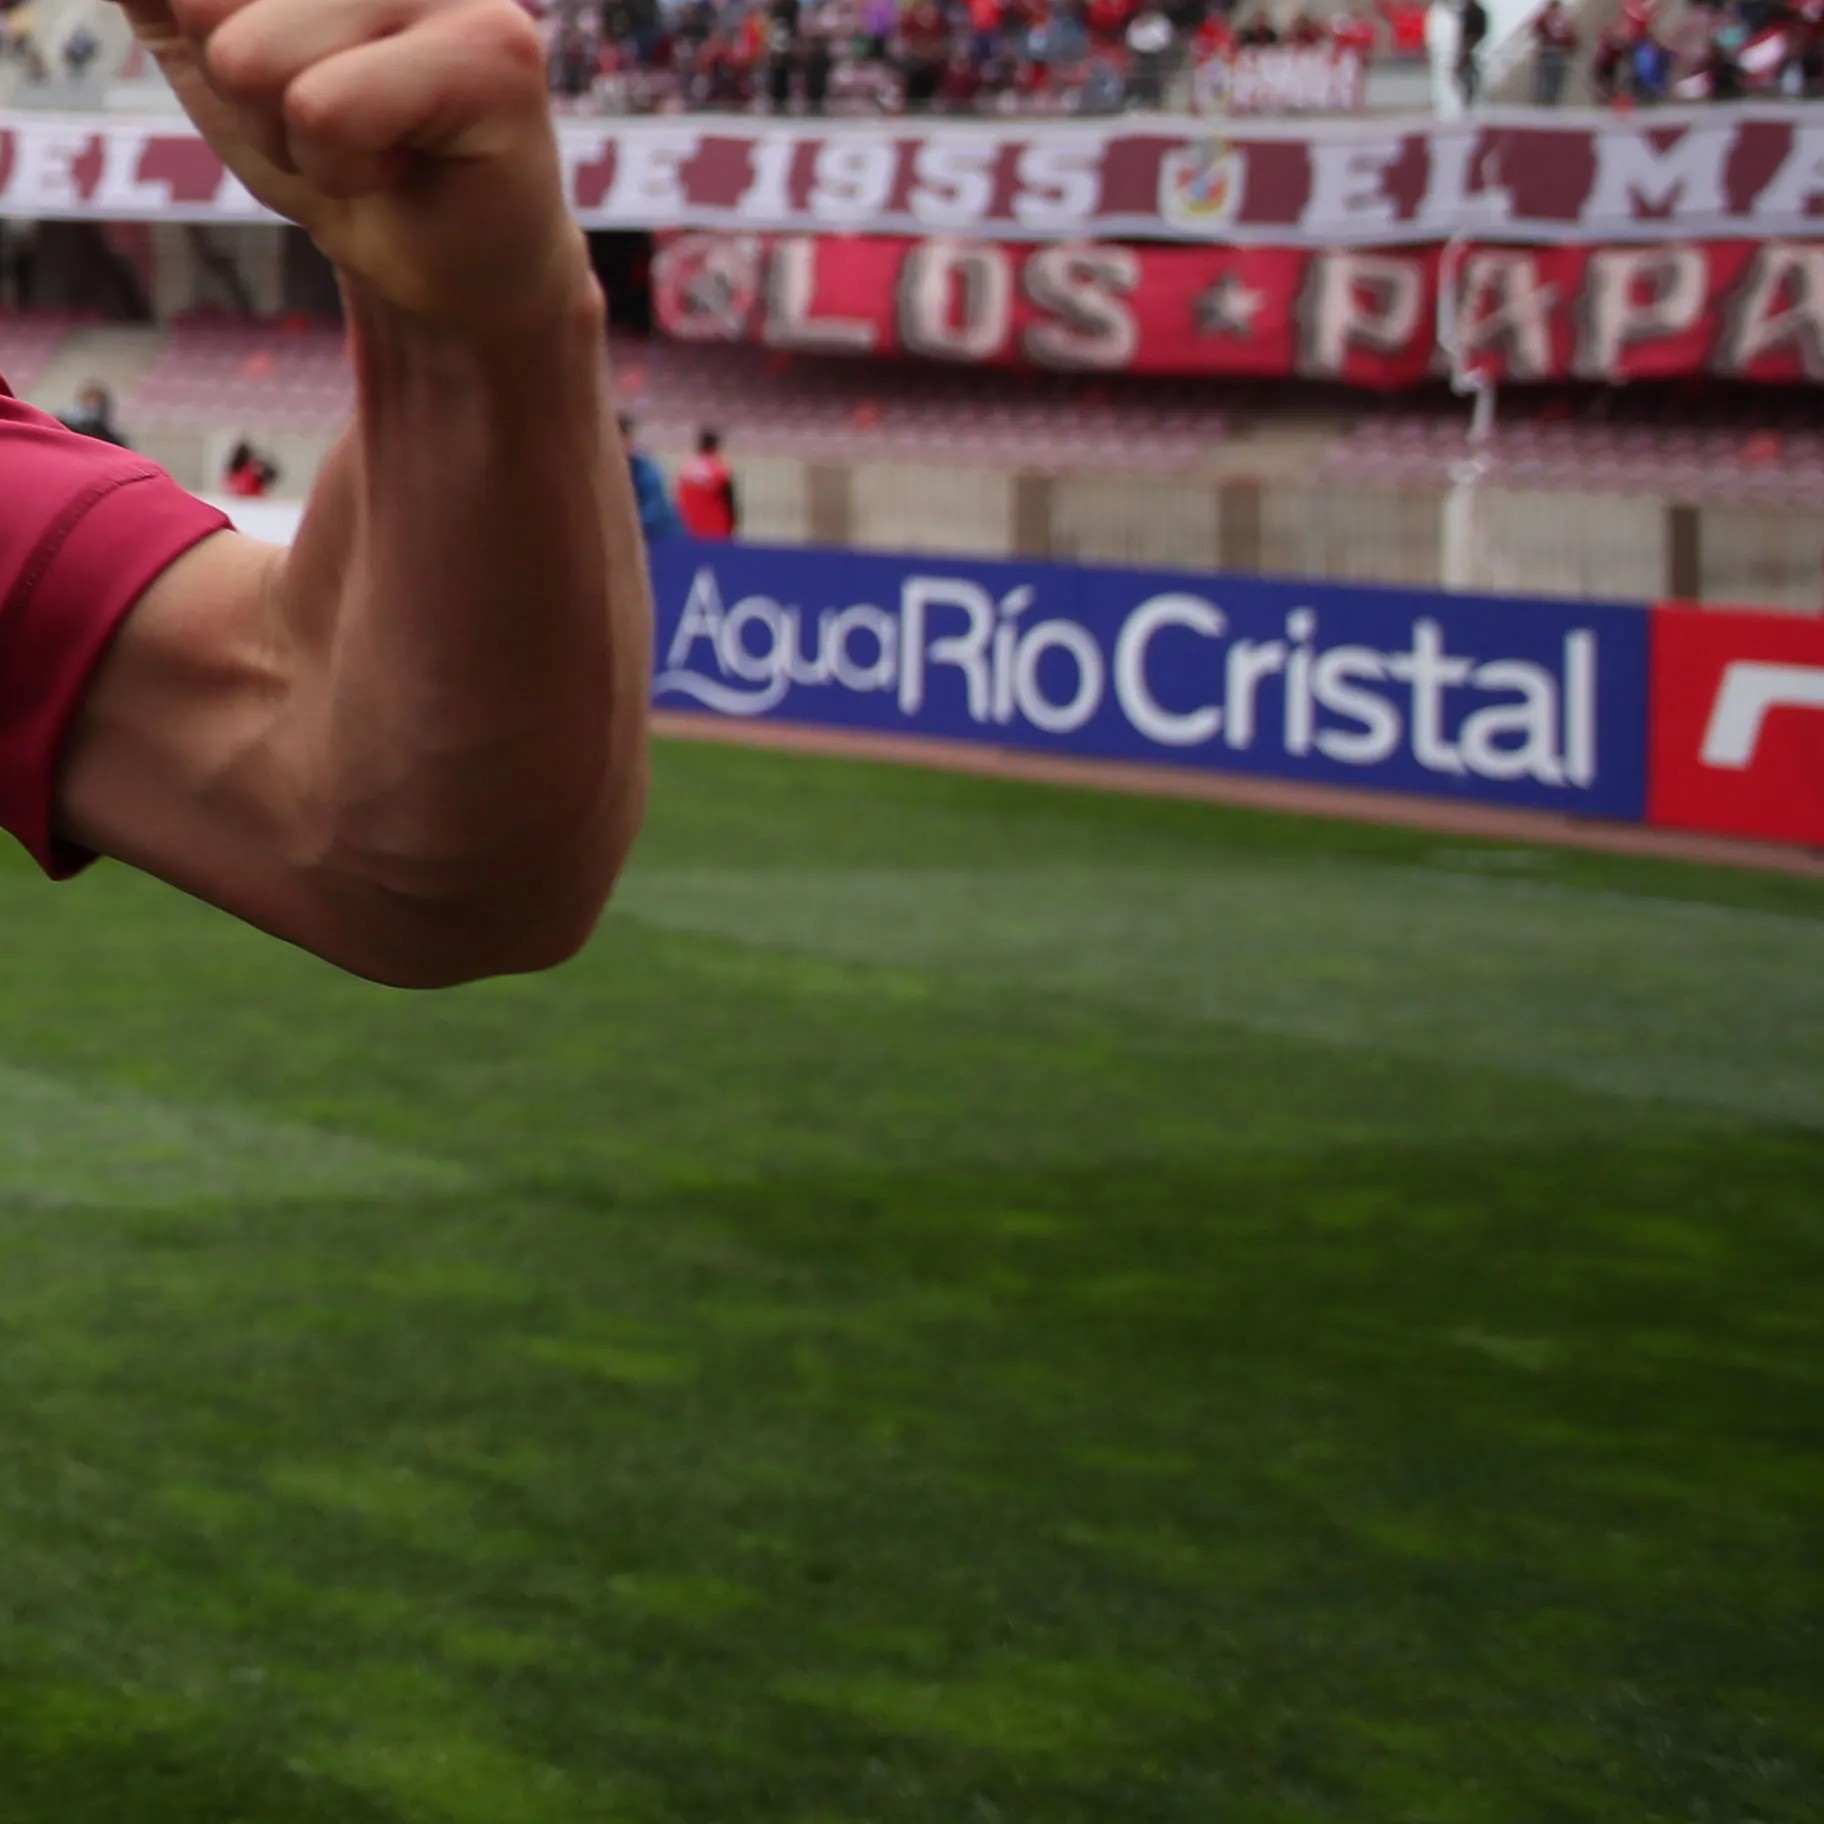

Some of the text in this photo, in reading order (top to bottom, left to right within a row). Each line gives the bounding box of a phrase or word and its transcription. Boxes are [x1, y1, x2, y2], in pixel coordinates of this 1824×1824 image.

[738, 131, 1103, 226] 1955
[1300, 133, 1514, 228] EL
[762, 232, 1144, 368] LOS
[1112, 589, 1598, 790] Cristal
